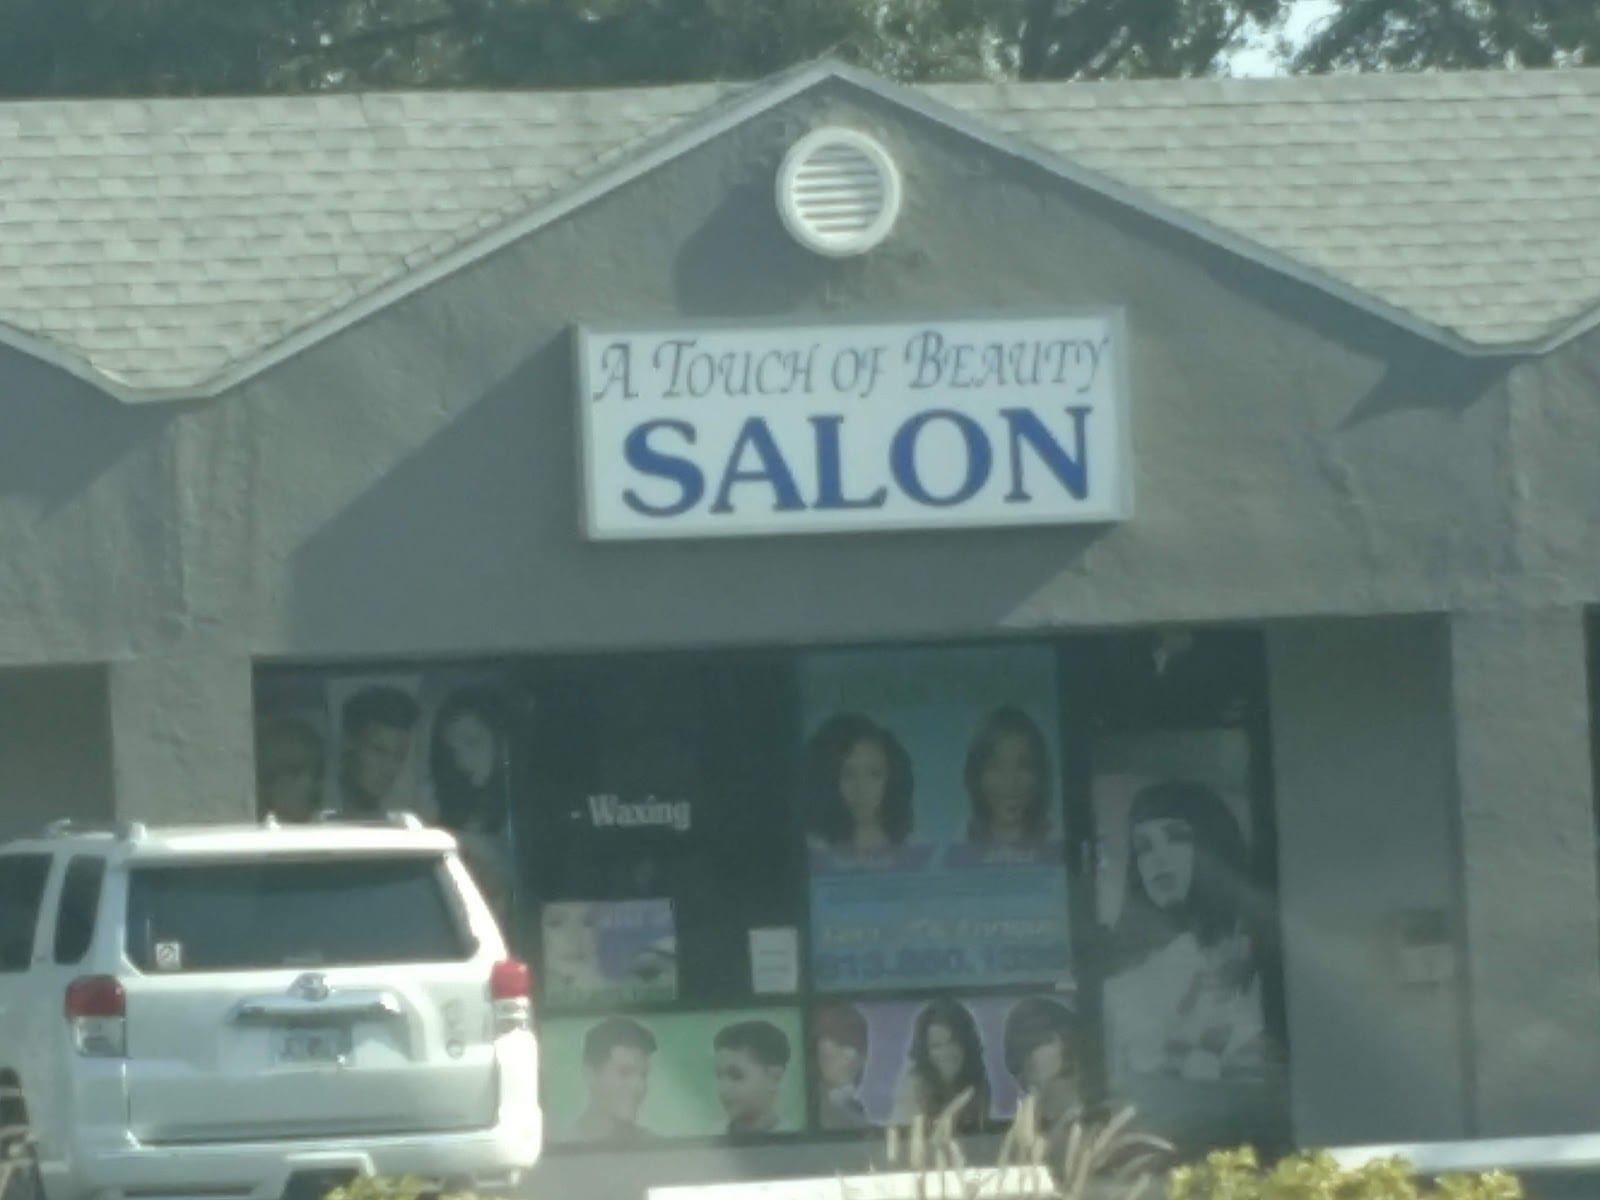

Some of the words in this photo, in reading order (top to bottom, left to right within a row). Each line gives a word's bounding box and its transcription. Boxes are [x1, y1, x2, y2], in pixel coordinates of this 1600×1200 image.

[594, 341, 639, 401] A
[653, 339, 821, 399] TOUCH
[831, 345, 888, 398] OF
[904, 330, 1110, 394] BEAUTY
[622, 406, 1092, 518] SALON
[588, 794, 691, 831] Waxing
